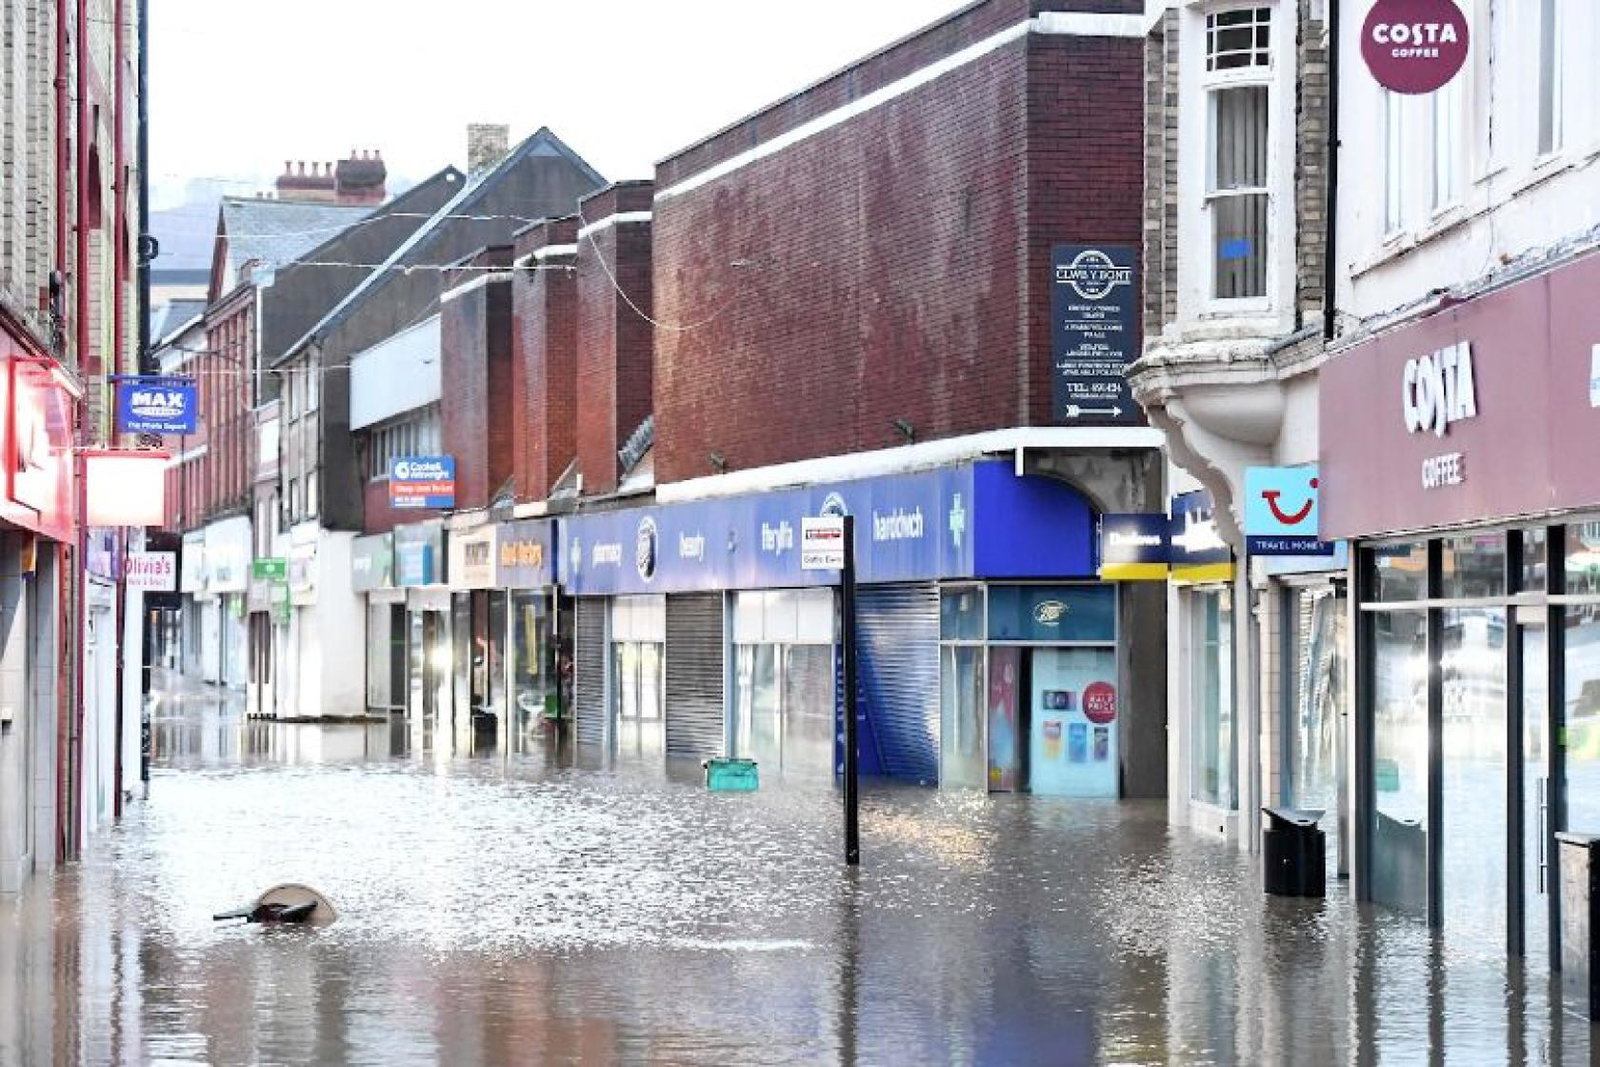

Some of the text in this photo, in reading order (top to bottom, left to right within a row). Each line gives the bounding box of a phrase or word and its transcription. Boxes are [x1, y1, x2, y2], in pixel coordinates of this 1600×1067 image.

[1372, 23, 1458, 46] COSTA
[1391, 48, 1439, 58] COFFEE
[1090, 270, 1098, 280] Y
[1403, 340, 1477, 438] COSTA
[132, 392, 184, 408] MAX
[1421, 453, 1466, 489] COFFEE
[1255, 540, 1325, 551] TRAVEL MONEY
[125, 554, 171, 575] Olivia's
